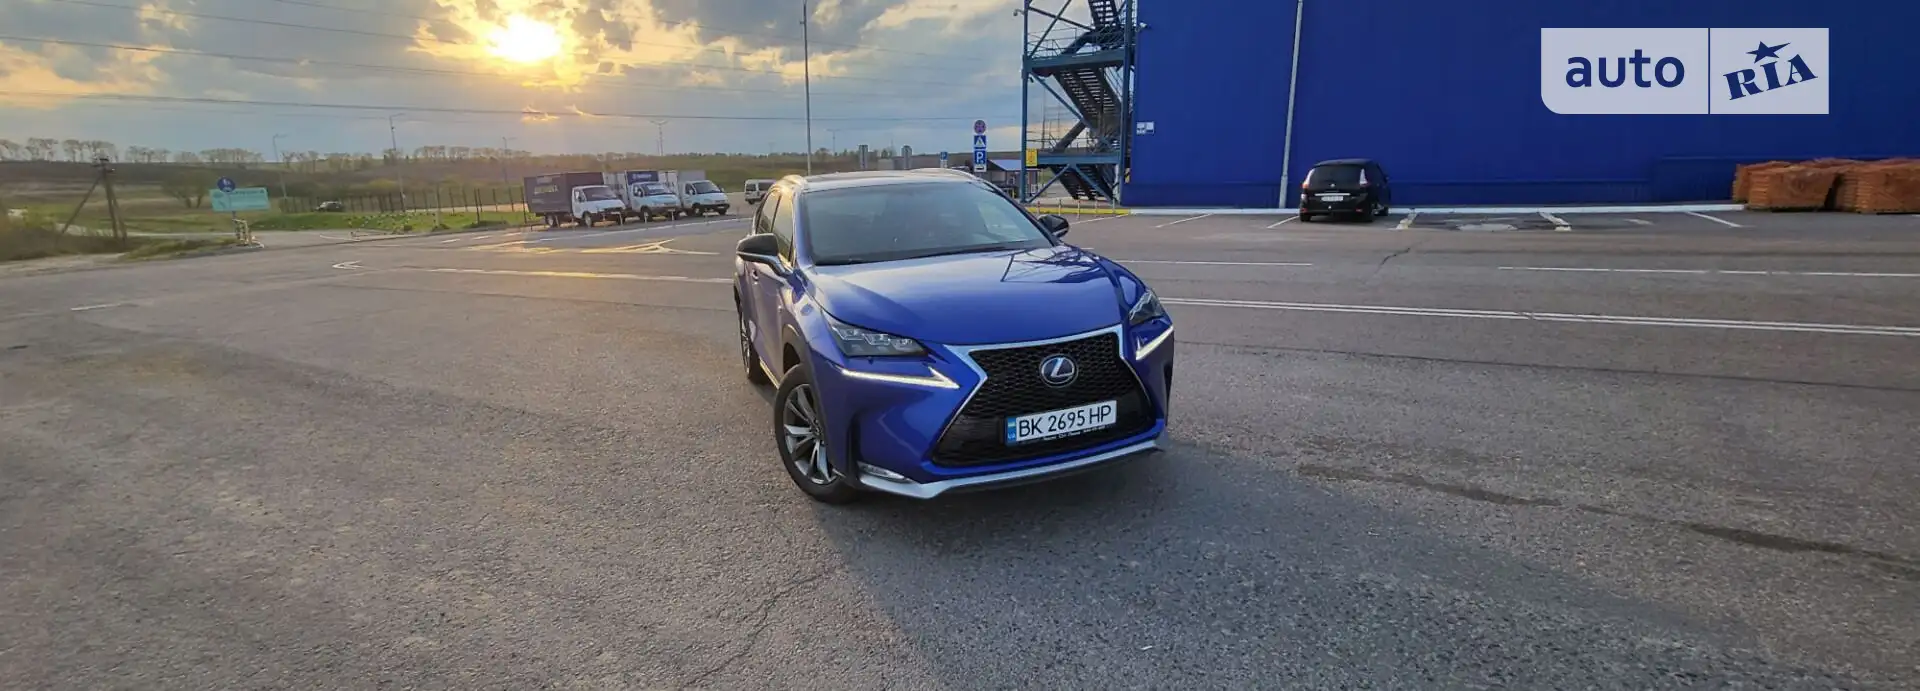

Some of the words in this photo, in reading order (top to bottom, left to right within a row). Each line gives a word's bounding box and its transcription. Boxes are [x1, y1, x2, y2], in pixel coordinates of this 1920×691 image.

[1019, 418, 1043, 437] BK
[1048, 410, 1085, 432] 2695
[1089, 405, 1111, 424] HP
